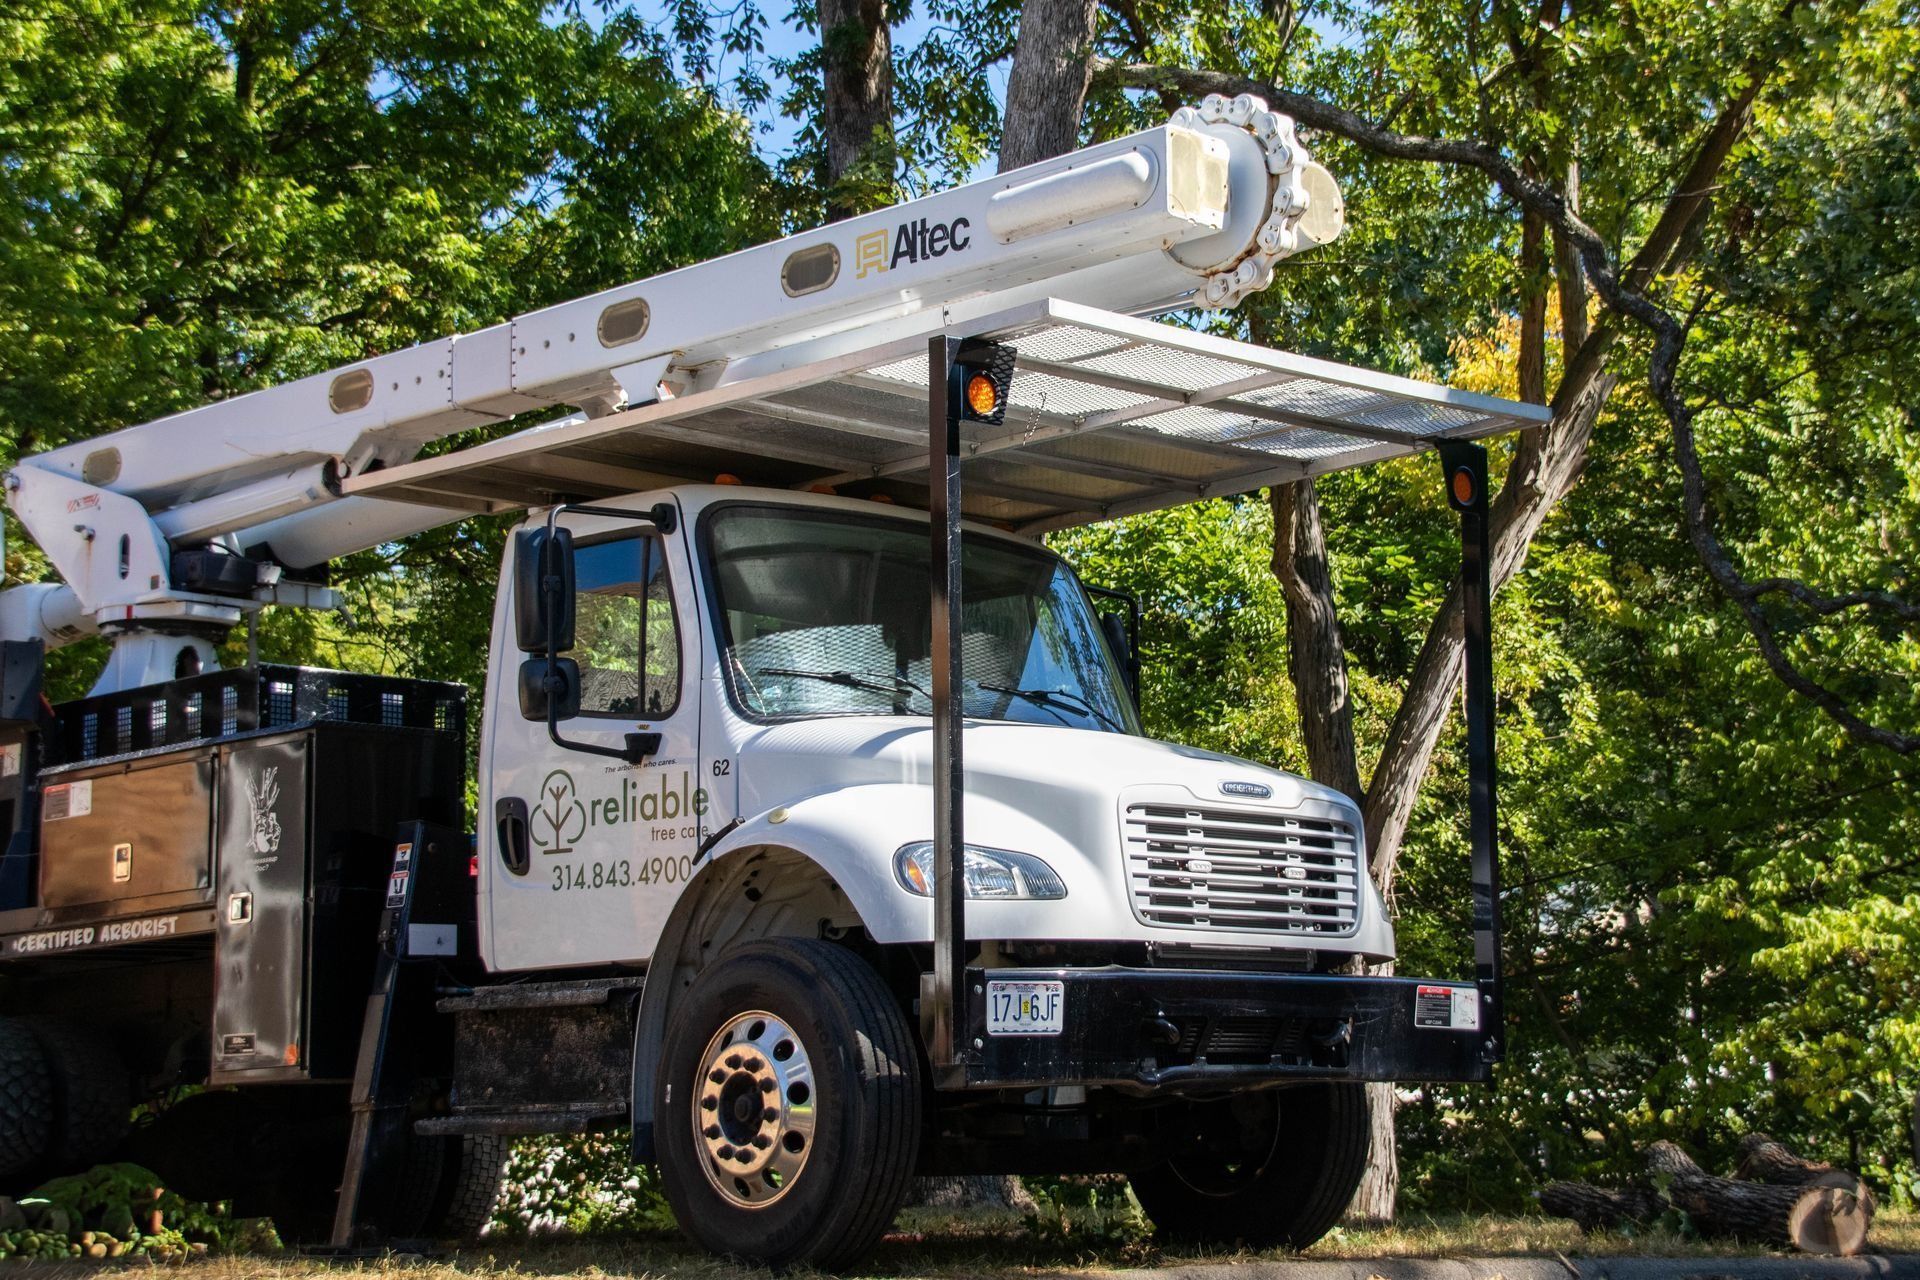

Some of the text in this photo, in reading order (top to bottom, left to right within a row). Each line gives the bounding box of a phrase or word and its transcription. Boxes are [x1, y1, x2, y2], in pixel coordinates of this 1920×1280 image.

[890, 216, 970, 270] Altec
[712, 759, 730, 776] 62
[591, 771, 709, 826] reliable
[651, 826, 676, 841] tree
[552, 855, 692, 891] 314.843.4900
[17, 916, 178, 953] CERTIFIED ARBORIST
